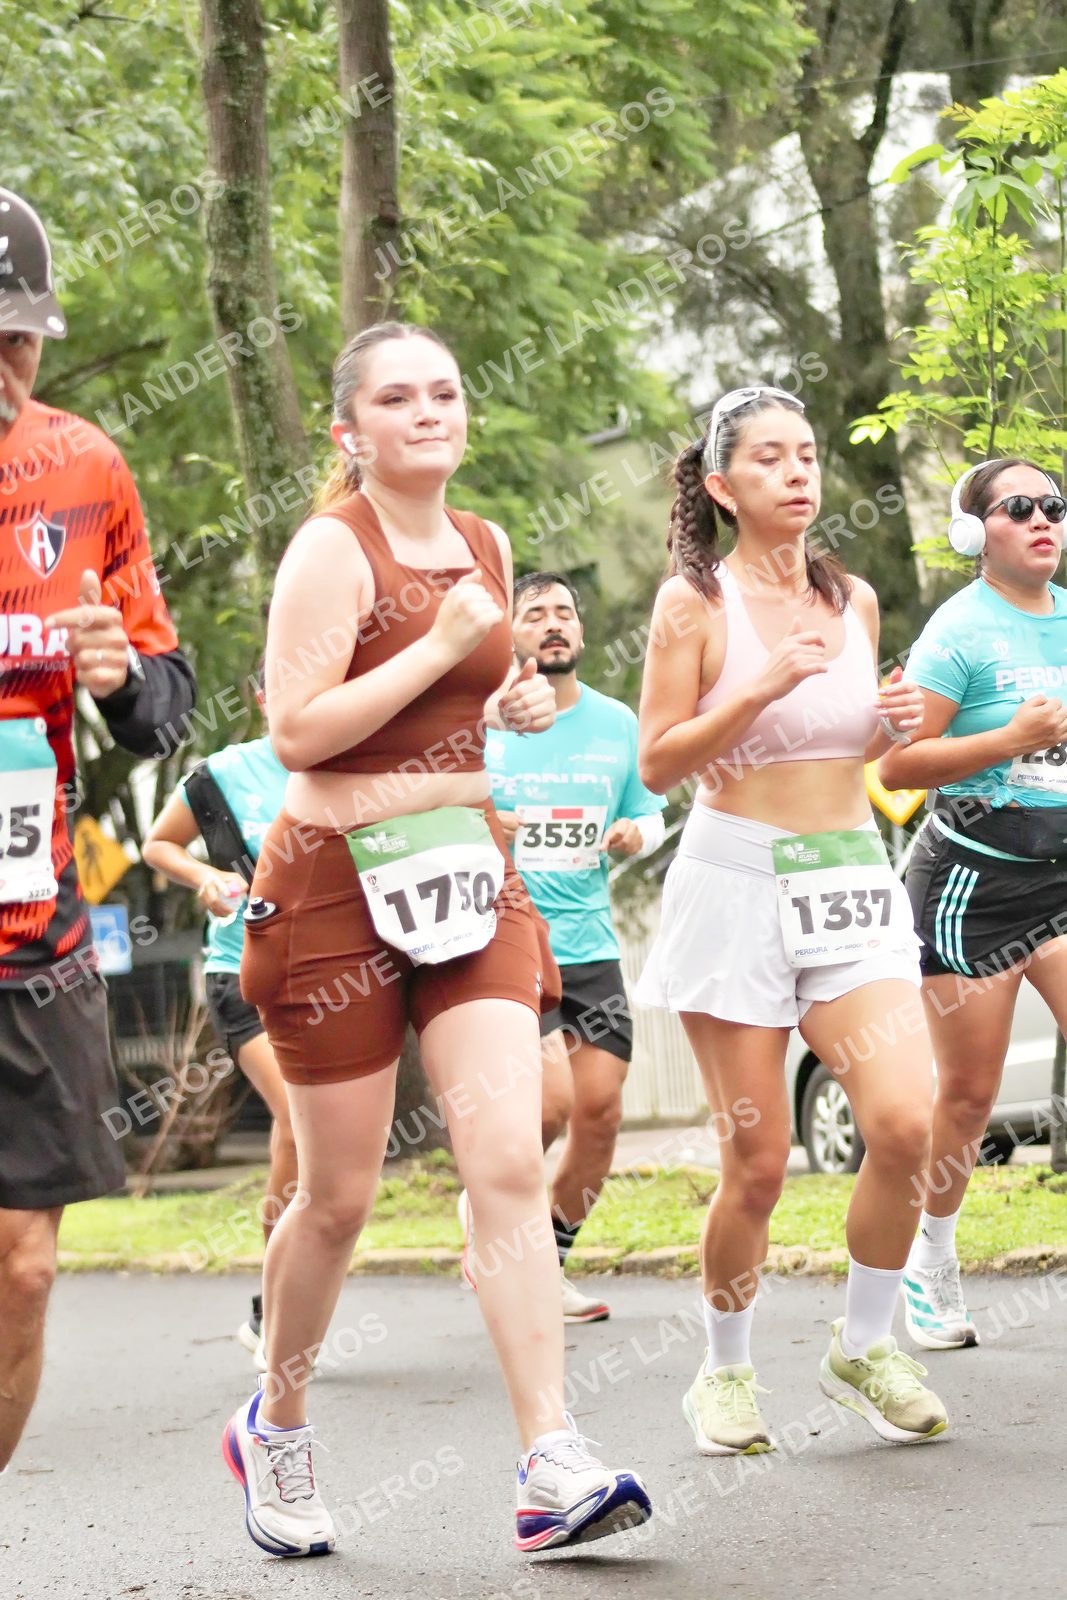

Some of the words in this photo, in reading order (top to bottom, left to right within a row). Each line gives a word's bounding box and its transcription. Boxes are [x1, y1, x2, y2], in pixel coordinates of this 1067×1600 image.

[995, 665, 1067, 692] PERD
[0, 804, 42, 858] 5
[523, 822, 598, 848] 3539
[384, 871, 496, 935] 1750
[791, 888, 892, 935] 1337
[795, 945, 828, 957] PERDURA
